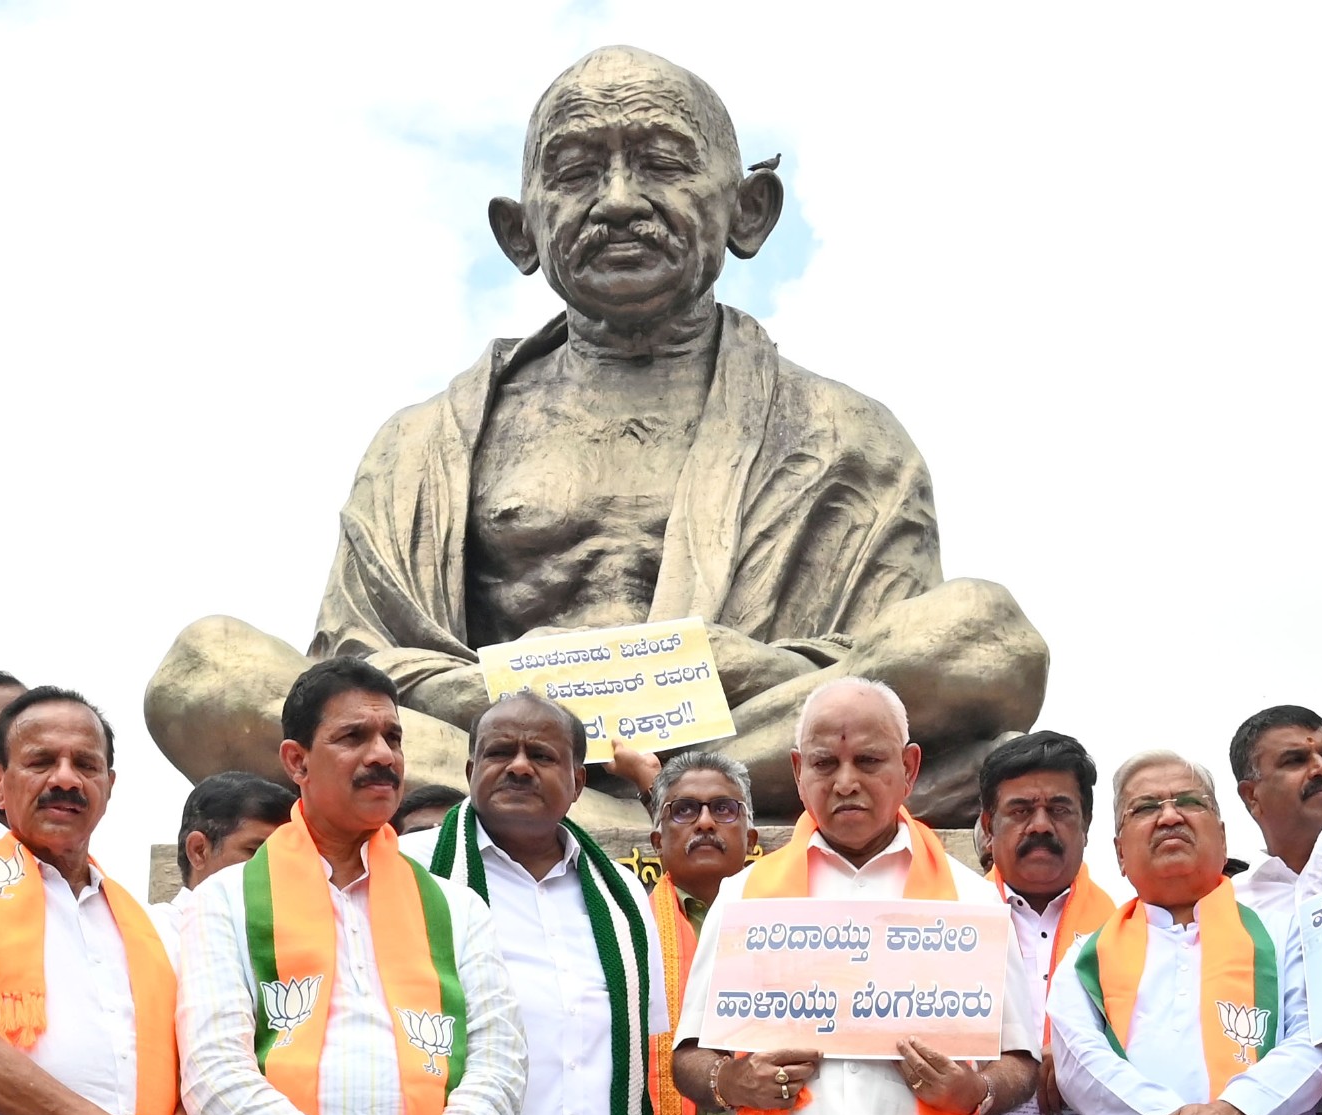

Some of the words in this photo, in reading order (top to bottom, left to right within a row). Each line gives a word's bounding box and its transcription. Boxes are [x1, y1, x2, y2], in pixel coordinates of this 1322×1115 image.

[510, 644, 611, 672] ತಮಿಳುನಾಡು
[620, 633, 682, 659] ಏಜೆಂಟ್
[546, 672, 645, 700] ಶಿವಕುಮಾರ್
[654, 661, 710, 688] ರವರಿಗೆ
[618, 701, 696, 739] ಧಿಕ್ಕಾರ!!
[746, 919, 871, 963] ಬರಿದಾಯ್ತು
[886, 919, 978, 952] ಕಾವೇರಿ
[716, 982, 838, 1033] ಹಾಳಾಯ್ತು
[851, 981, 992, 1019] ಬೆಂಗಳೂರು
